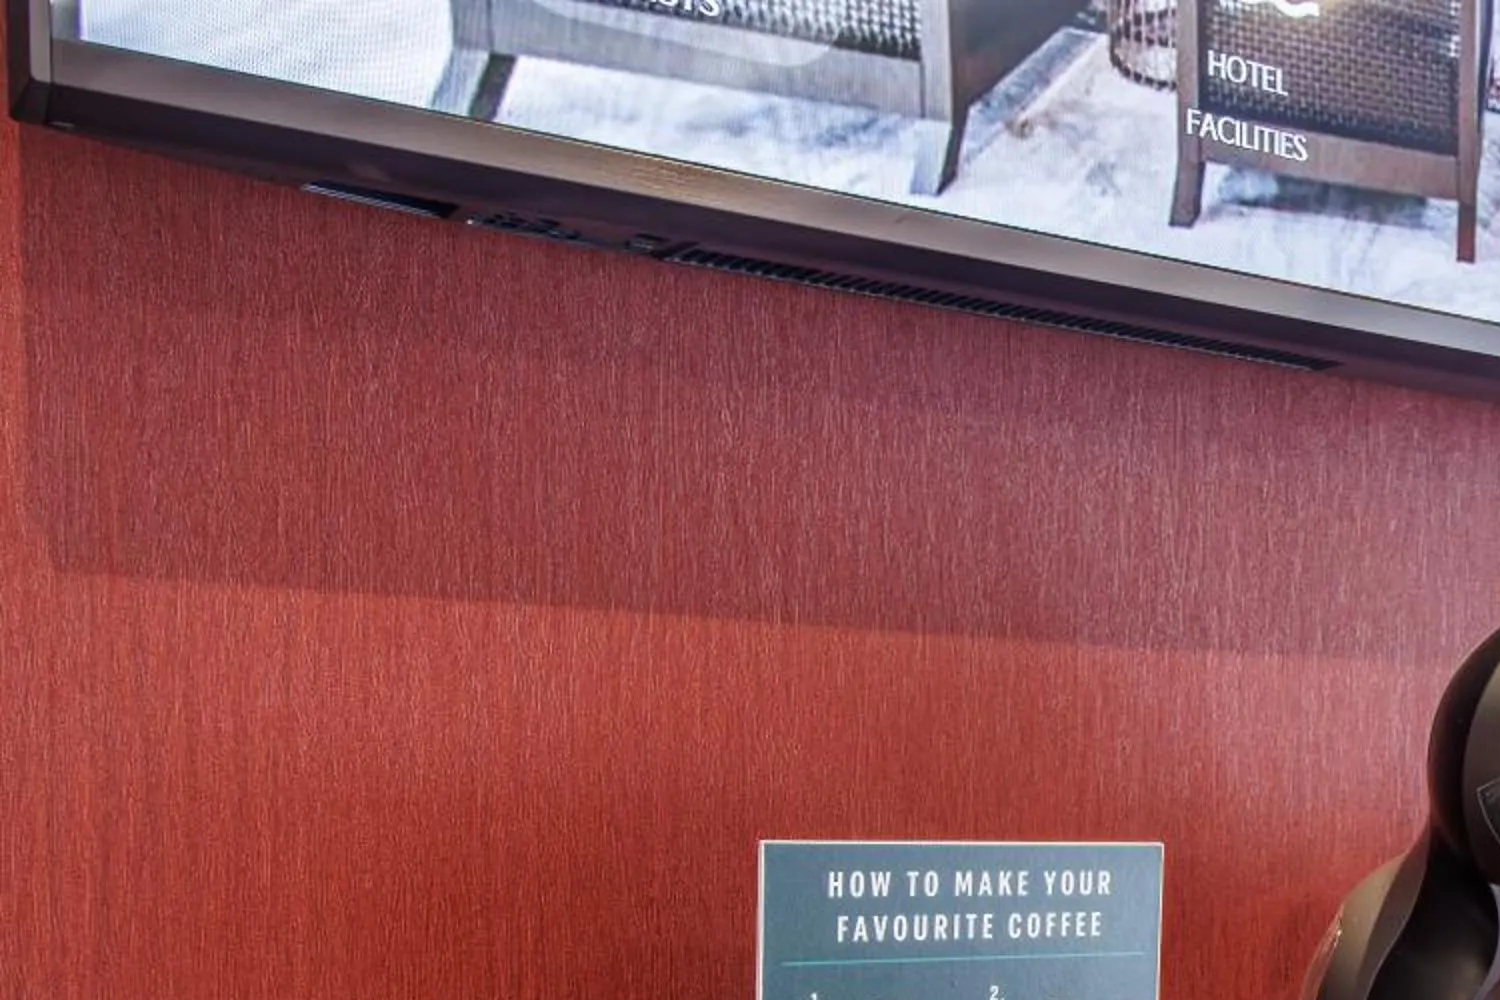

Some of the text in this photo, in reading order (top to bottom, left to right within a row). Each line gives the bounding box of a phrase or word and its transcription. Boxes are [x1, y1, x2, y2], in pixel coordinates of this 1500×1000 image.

[1207, 49, 1289, 97] HOTEL
[1186, 107, 1309, 162] FACILITIES
[827, 869, 1112, 899] HOW TO MAKE YOUR
[836, 910, 1103, 944] FAVOURITE COFFEE
